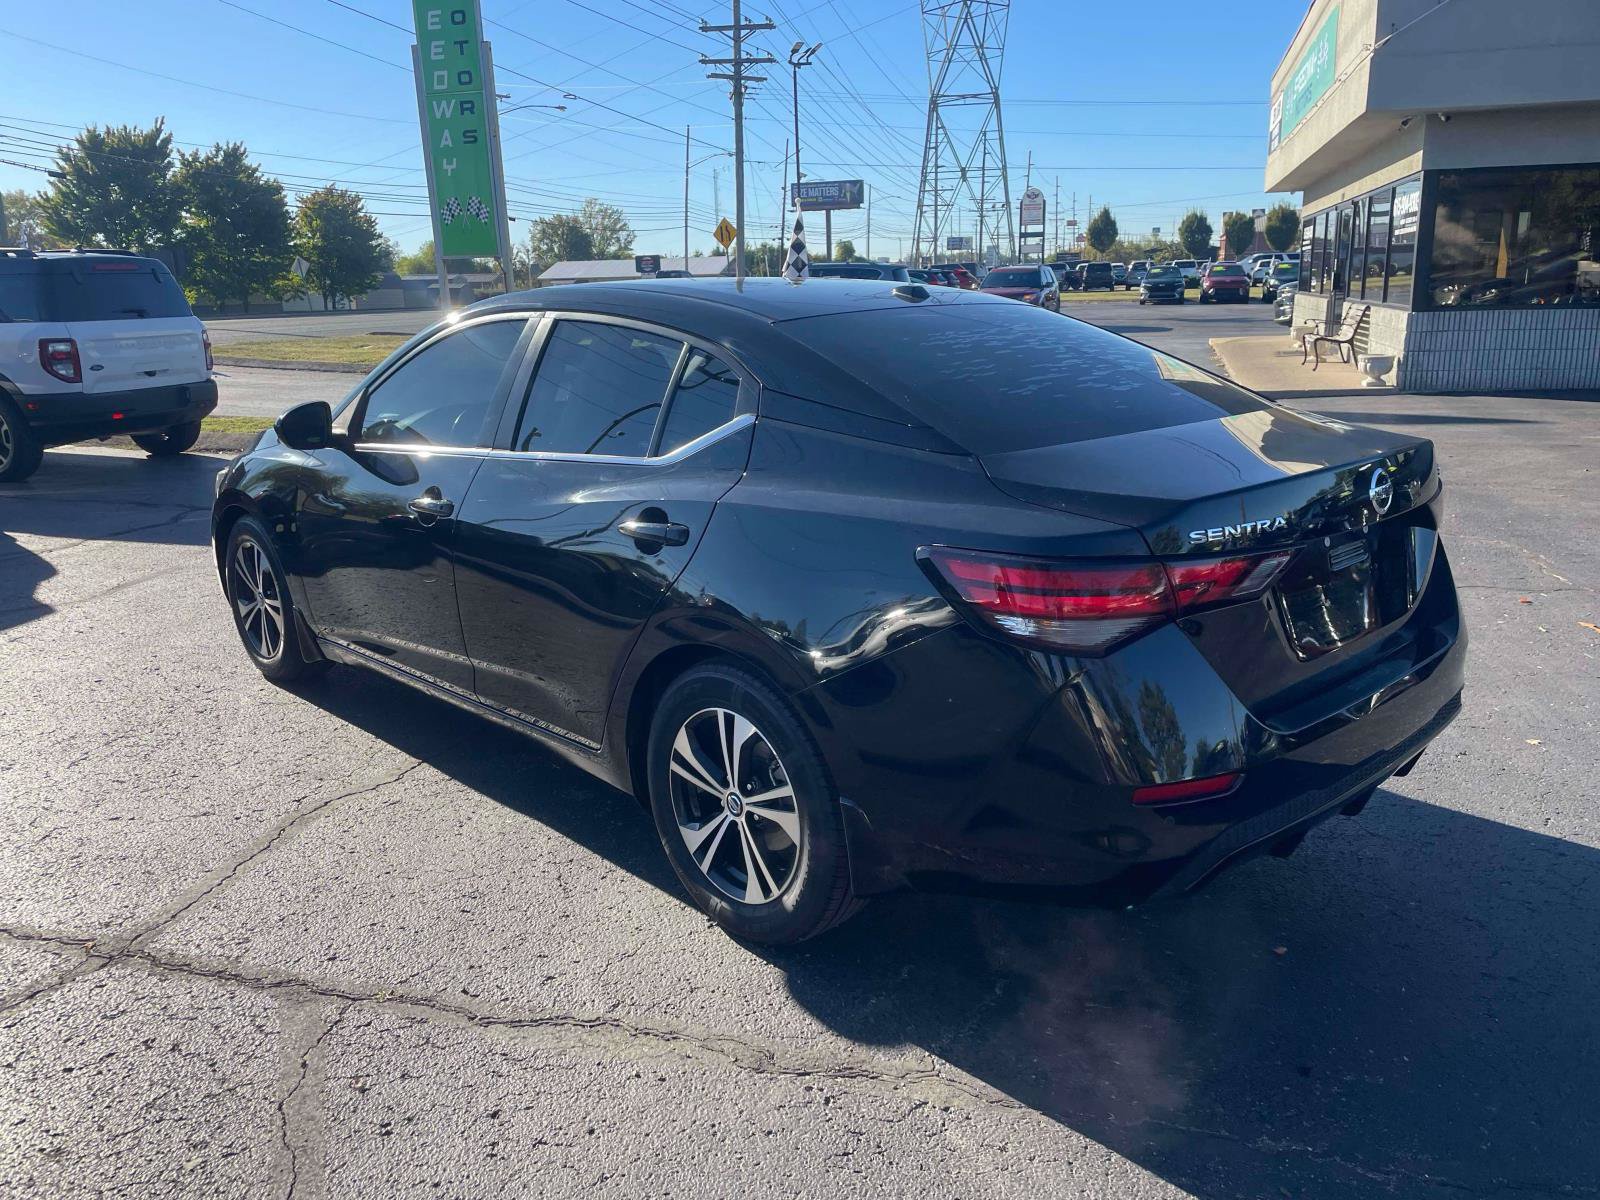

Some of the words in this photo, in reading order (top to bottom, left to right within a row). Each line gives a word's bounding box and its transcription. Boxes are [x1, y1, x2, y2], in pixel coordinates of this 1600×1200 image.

[793, 188, 808, 198] SZE
[808, 187, 839, 197] MATTERS
[1188, 515, 1286, 545] SENTRA
